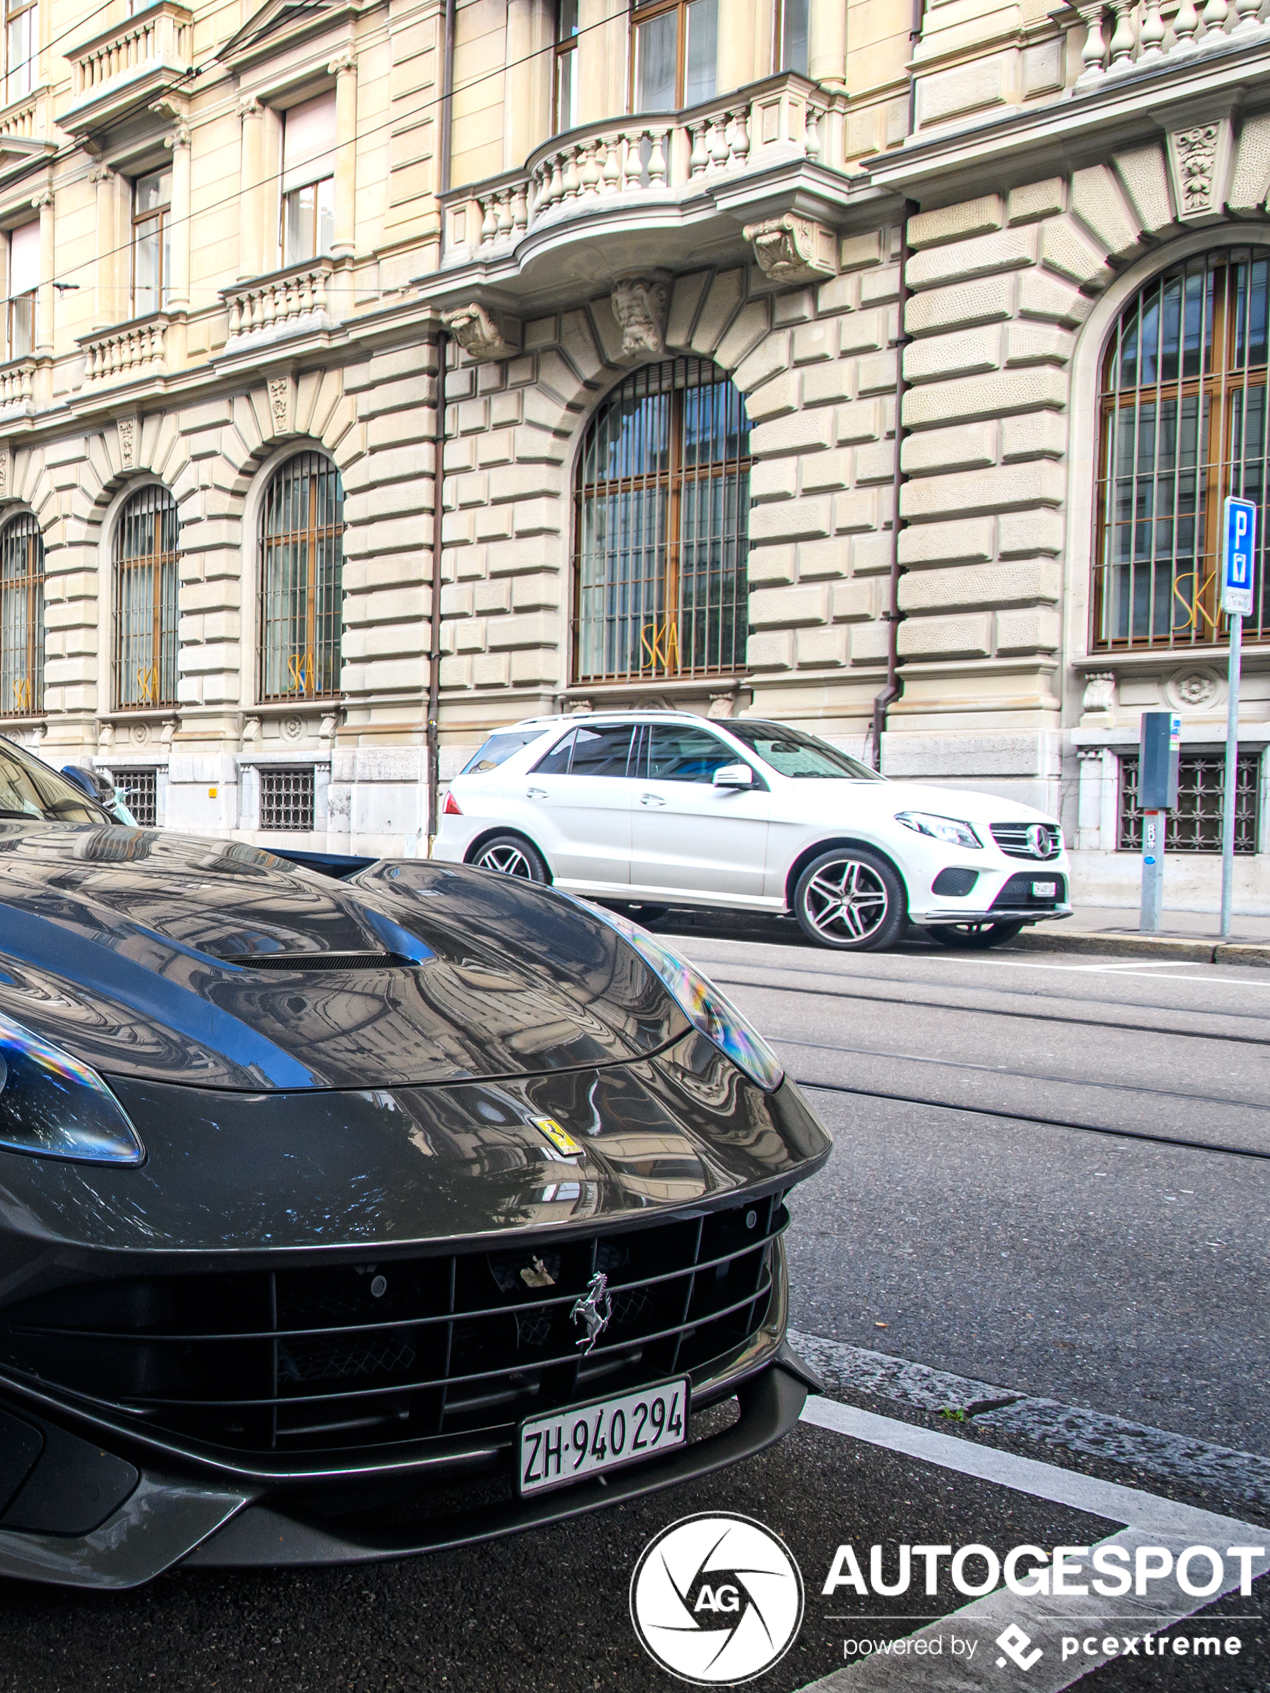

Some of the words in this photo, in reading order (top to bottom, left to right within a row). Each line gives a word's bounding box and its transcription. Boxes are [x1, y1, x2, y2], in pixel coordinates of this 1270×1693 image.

[1235, 510, 1247, 550] P
[1172, 571, 1221, 630] SK
[640, 622, 679, 669] SKA
[136, 667, 158, 701] SKA
[287, 653, 314, 691] SKA
[12, 678, 31, 709] SKA
